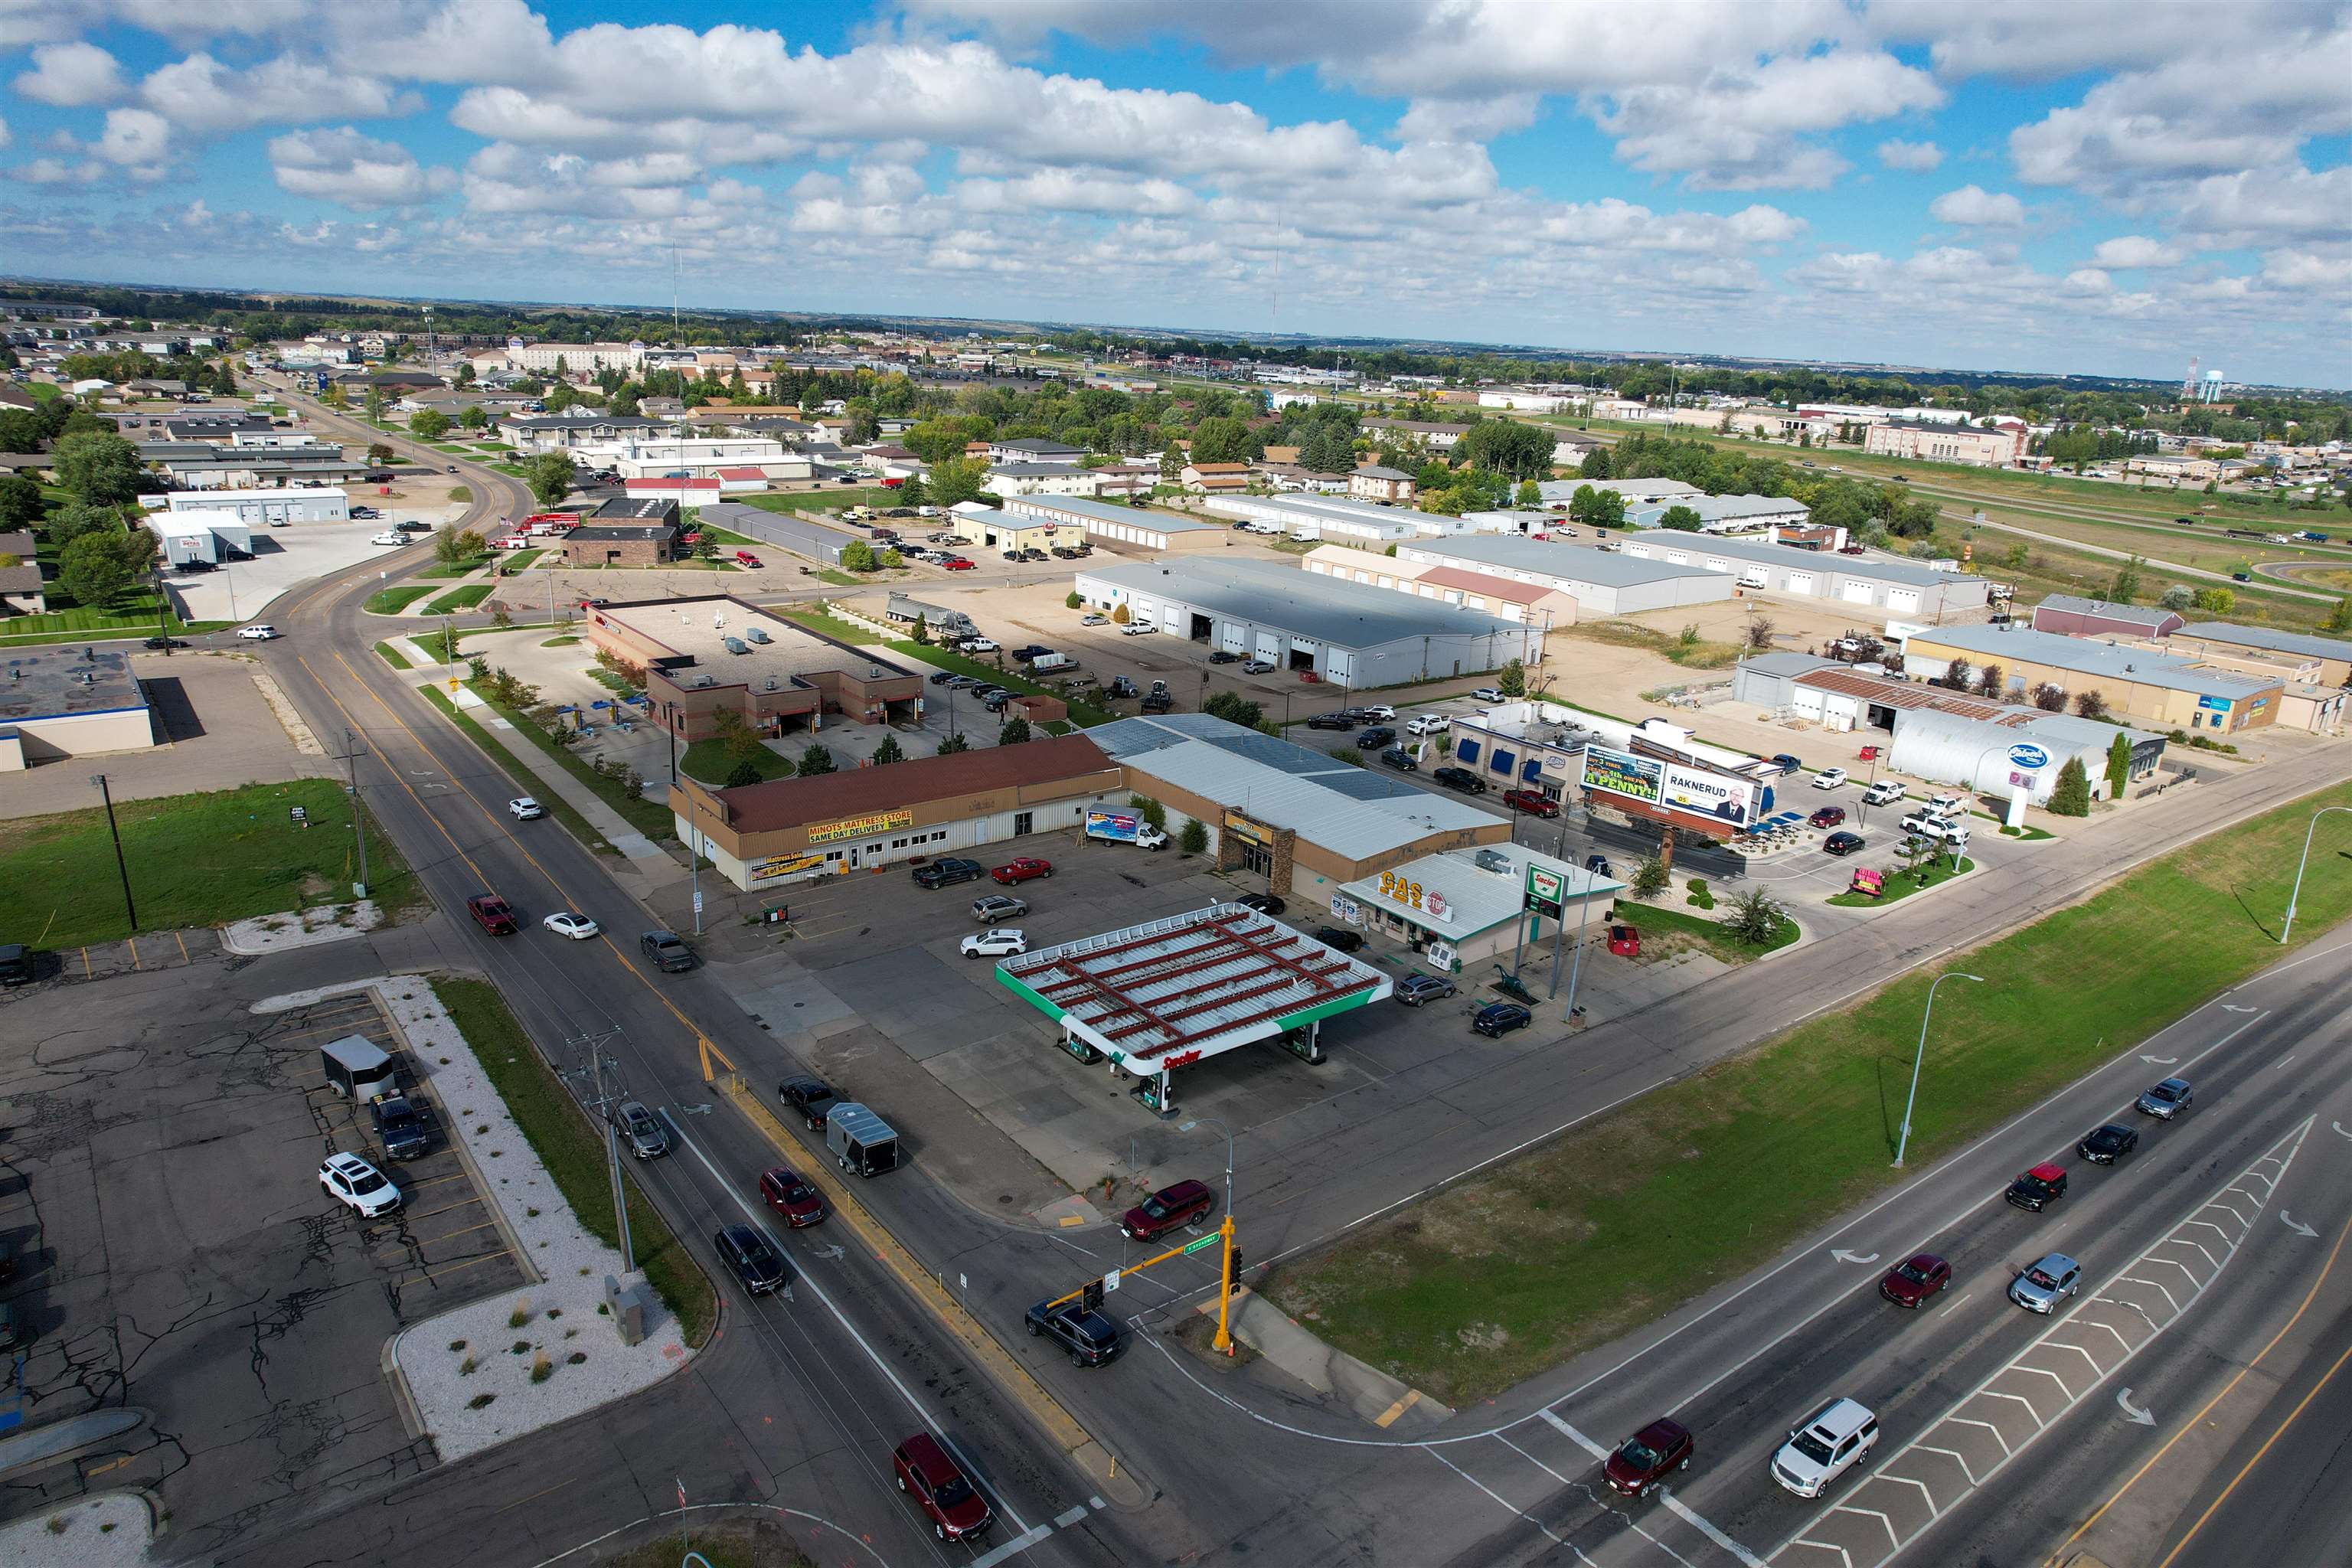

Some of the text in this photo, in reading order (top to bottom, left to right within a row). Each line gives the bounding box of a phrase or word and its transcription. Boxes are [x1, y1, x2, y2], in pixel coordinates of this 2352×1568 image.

[1586, 772, 1596, 784] A
[1597, 775, 1658, 800] PENNY!!
[1670, 776, 1726, 798] RAKNERUD
[809, 811, 911, 835] MINOTS MATTRESS STORE
[810, 824, 884, 843] SAME DAY DELIVERY
[766, 854, 791, 864] Mattress
[778, 861, 798, 871] Lease
[1382, 871, 1423, 900] GAS
[1426, 896, 1445, 911] STOP
[1430, 956, 1444, 966] ICE
[1193, 1236, 1216, 1249] BROADWAY
